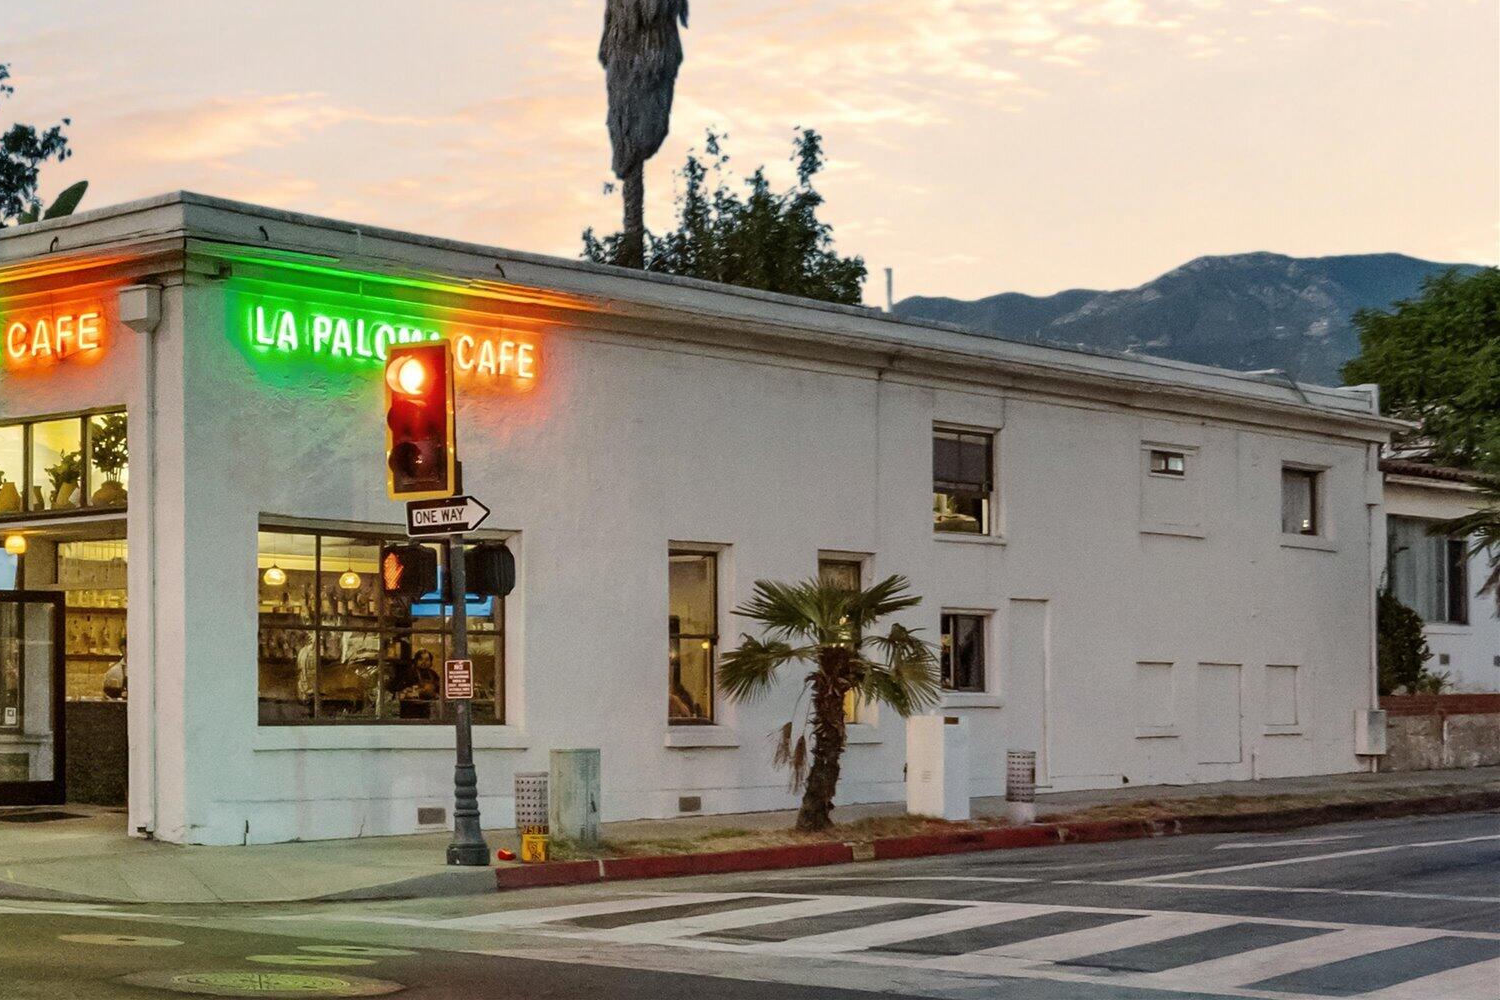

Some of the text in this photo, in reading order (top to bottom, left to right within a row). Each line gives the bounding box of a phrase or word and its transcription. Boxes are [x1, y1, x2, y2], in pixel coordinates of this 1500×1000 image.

[7, 312, 99, 359] CAFE
[255, 305, 534, 379] LA PALO CAFE
[415, 507, 465, 525] ONE WAY
